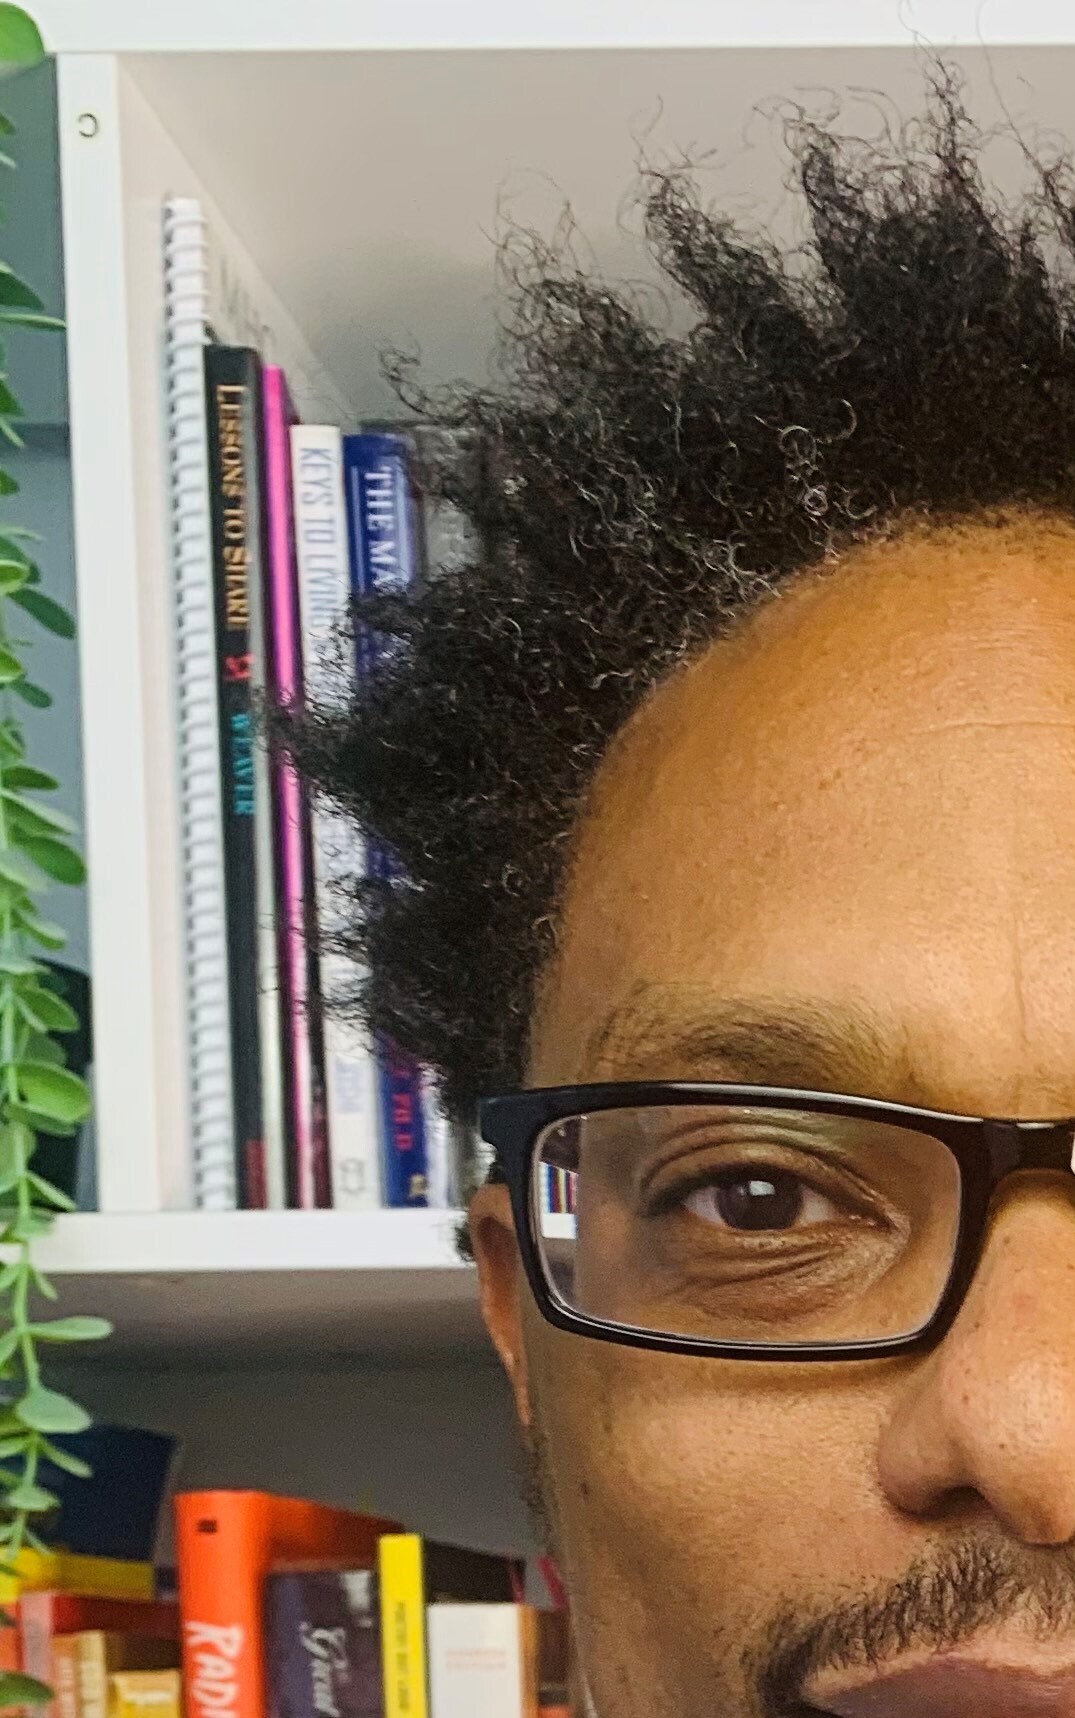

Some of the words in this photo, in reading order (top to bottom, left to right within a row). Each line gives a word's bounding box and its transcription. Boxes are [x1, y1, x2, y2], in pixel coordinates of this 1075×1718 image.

[215, 384, 249, 498] LESSONS
[299, 448, 336, 505] KEYS
[364, 466, 396, 532] THE
[222, 508, 246, 541] TO
[303, 515, 337, 545] TO
[222, 546, 252, 630] SHARE
[305, 554, 344, 629] LIVING
[368, 541, 400, 592] MA
